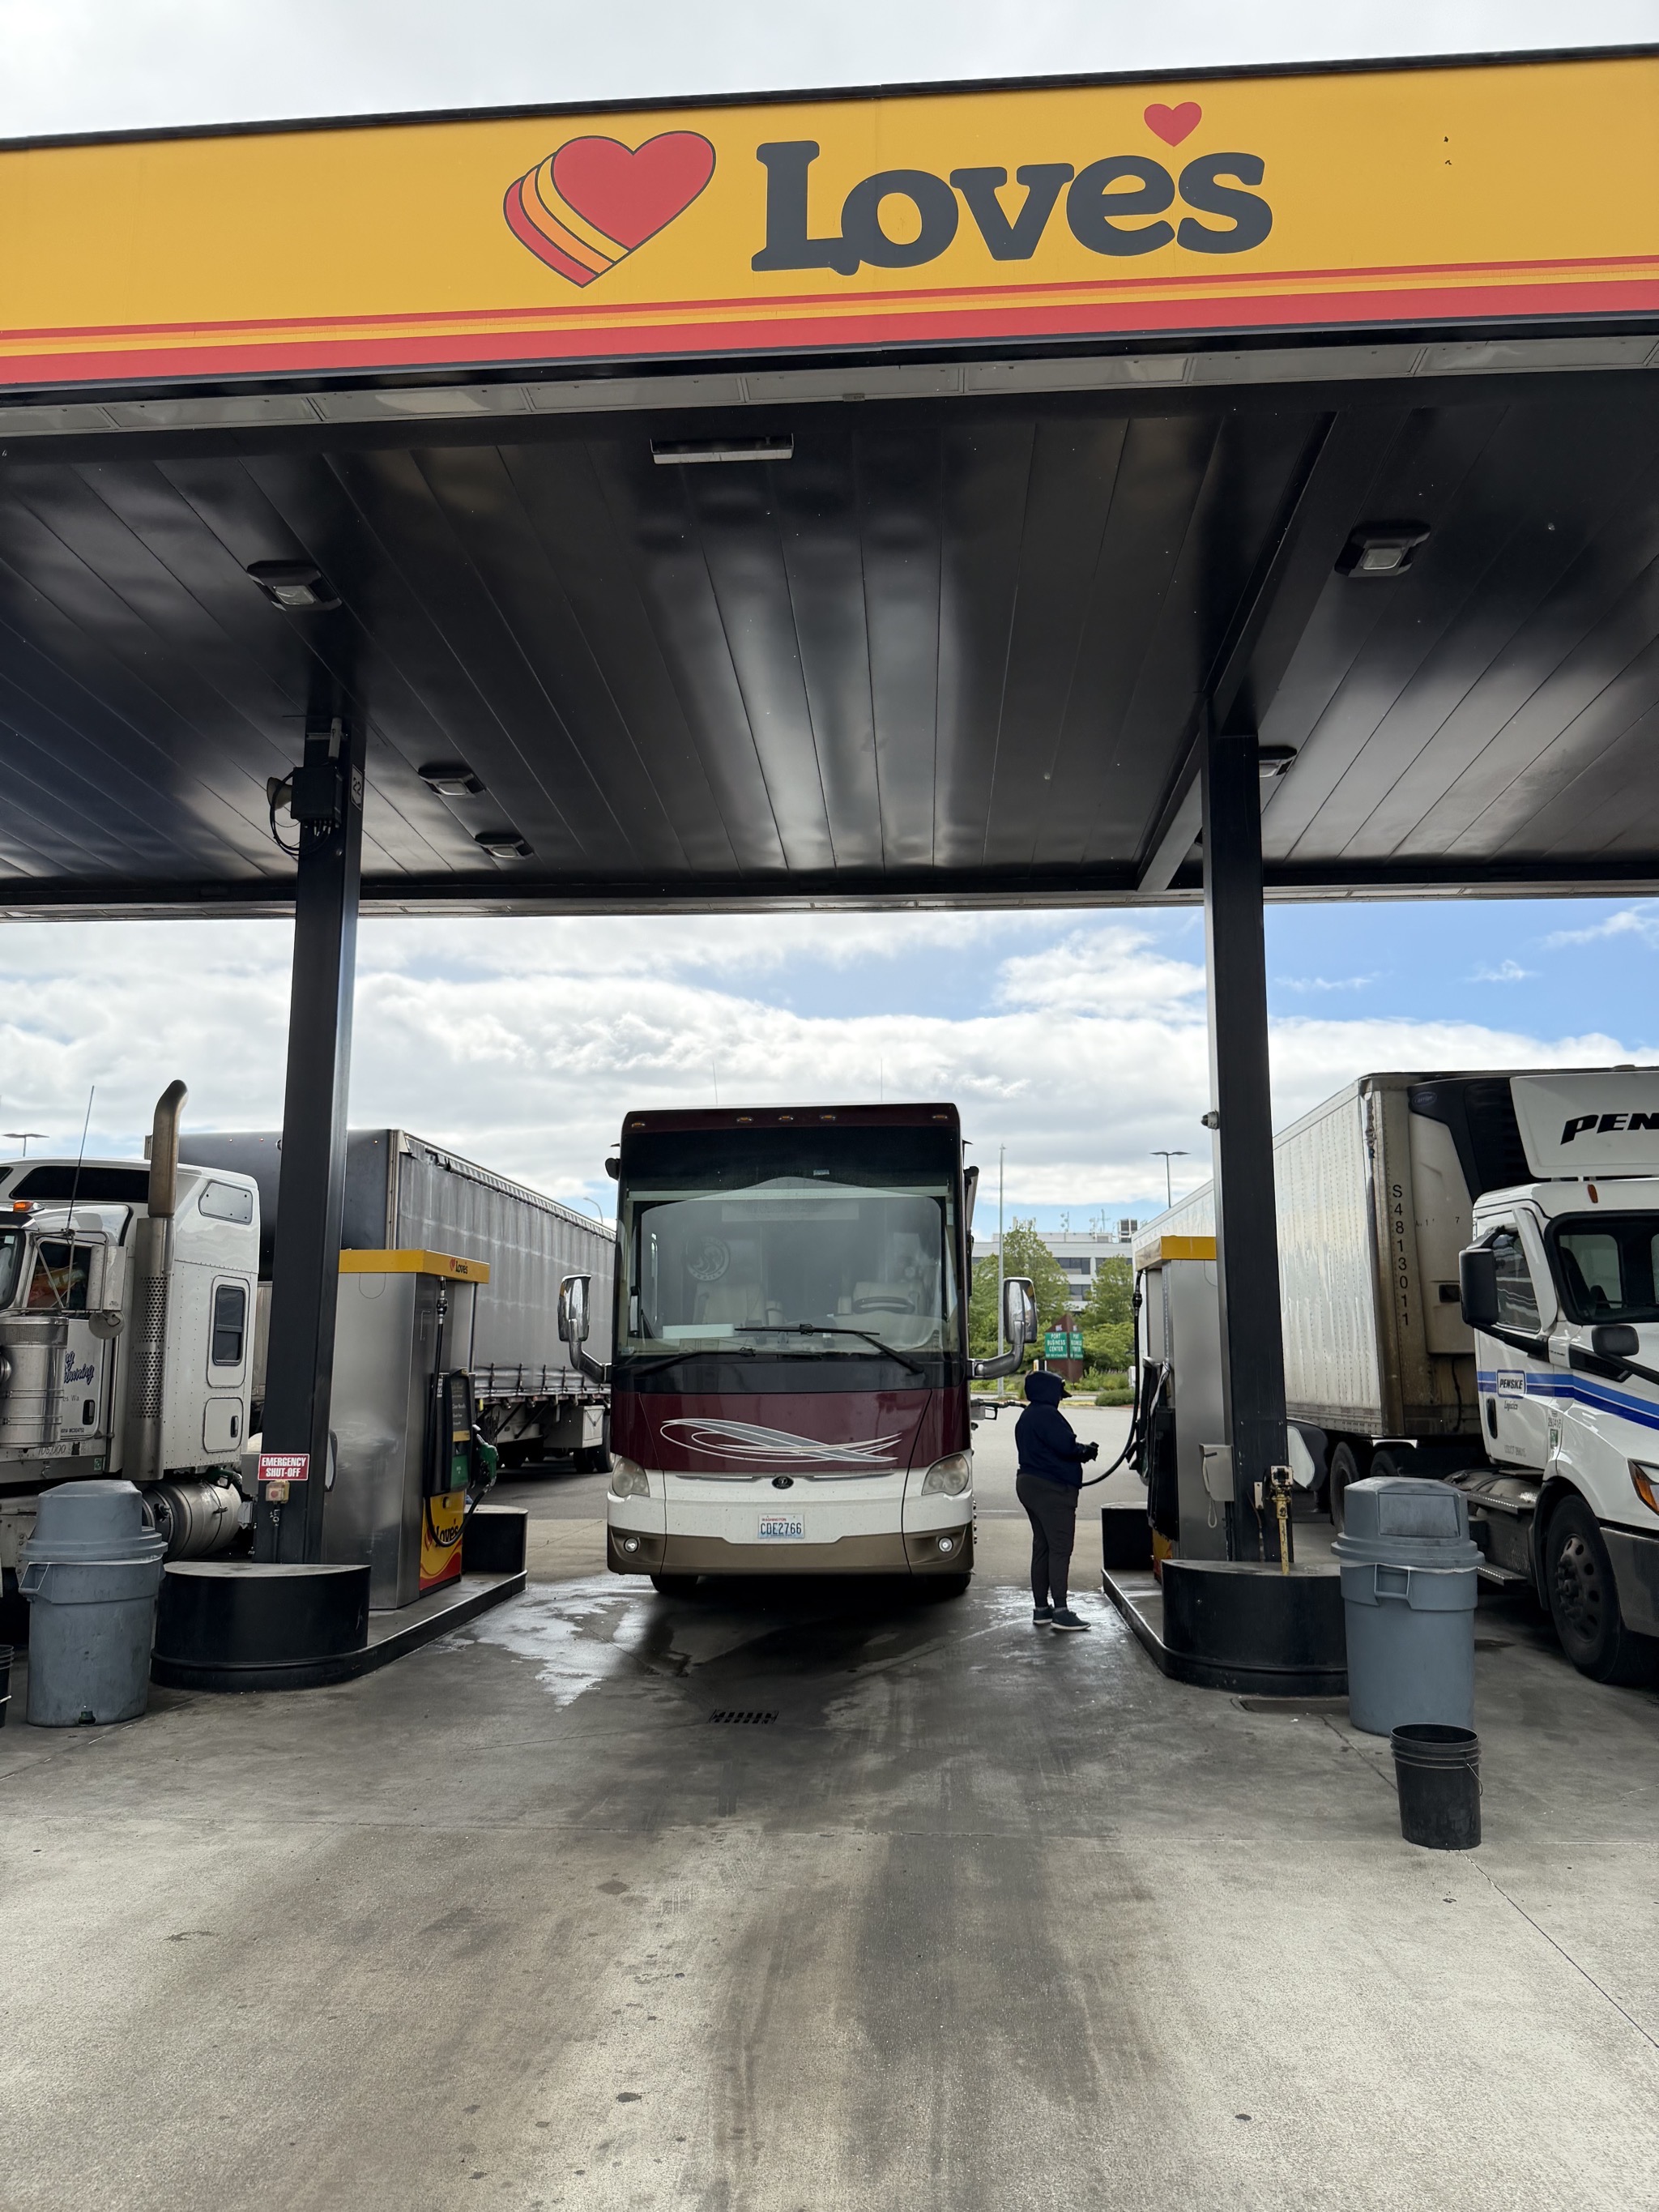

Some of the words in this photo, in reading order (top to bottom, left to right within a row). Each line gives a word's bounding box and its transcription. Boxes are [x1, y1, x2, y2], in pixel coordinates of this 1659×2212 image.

[353, 777, 361, 796] 22
[1560, 1112, 1659, 1145] PEN
[1499, 1379, 1524, 1390] PENSKE
[261, 1457, 307, 1467] EMERGENCY
[266, 1467, 301, 1477] SHUT-OFF
[761, 1522, 802, 1535] CDE2766
